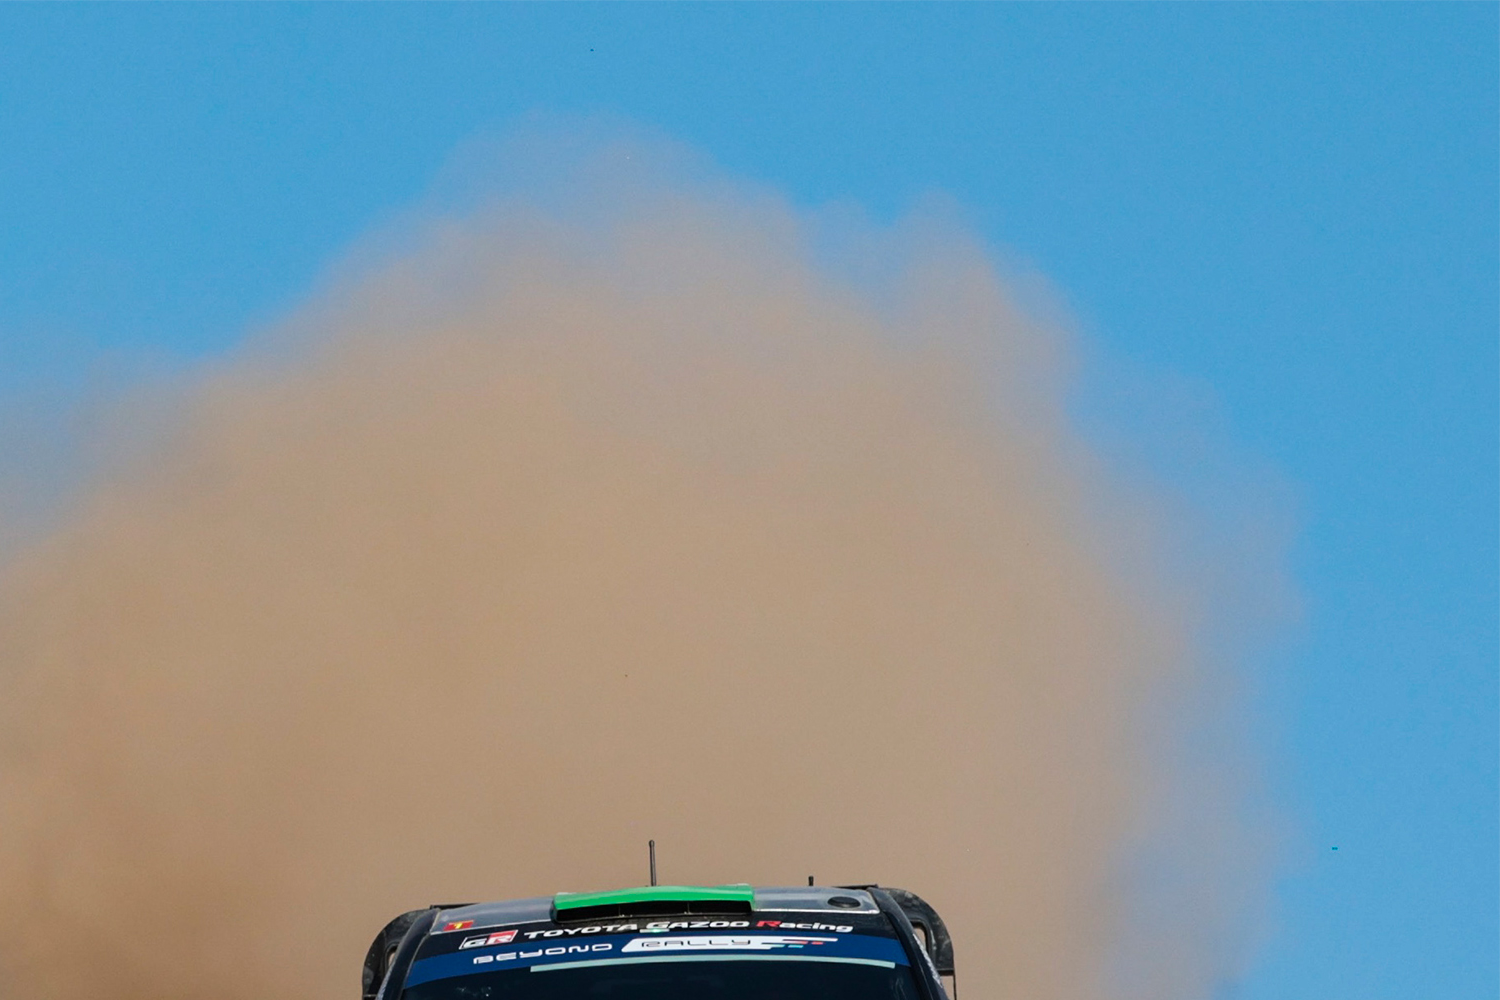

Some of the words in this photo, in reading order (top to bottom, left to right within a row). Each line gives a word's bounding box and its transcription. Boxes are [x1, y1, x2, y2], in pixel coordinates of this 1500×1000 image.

[461, 930, 517, 949] GR
[523, 923, 638, 940] TOYOTA
[646, 920, 750, 930] GAZOO
[756, 920, 854, 933] Racing
[472, 943, 613, 965] BEYOND
[641, 938, 751, 948] RALLY
